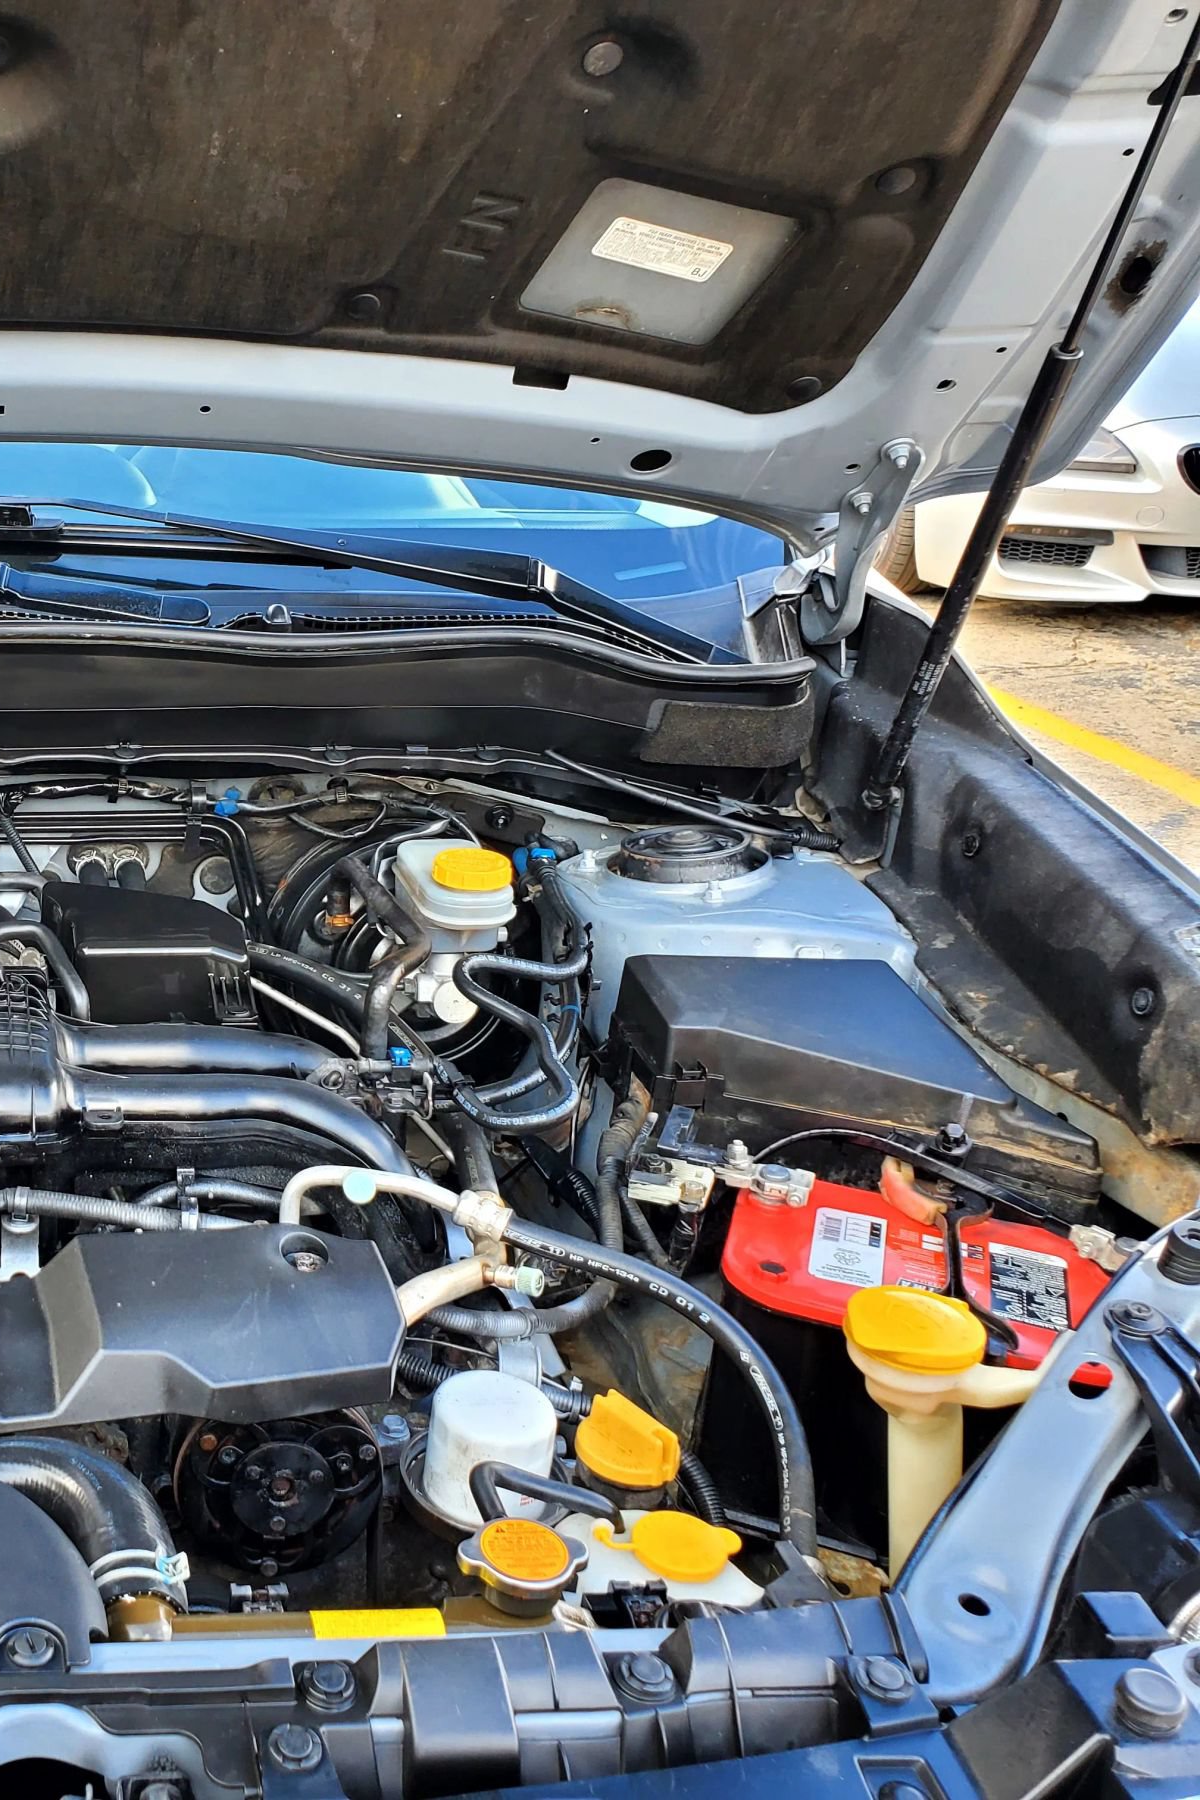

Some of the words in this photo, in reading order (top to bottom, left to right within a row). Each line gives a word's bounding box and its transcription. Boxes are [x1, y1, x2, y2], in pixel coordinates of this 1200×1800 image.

[691, 267, 708, 278] BJ
[569, 1253, 584, 1262] HP
[648, 1282, 669, 1296] CD
[699, 1311, 712, 1324] 2
